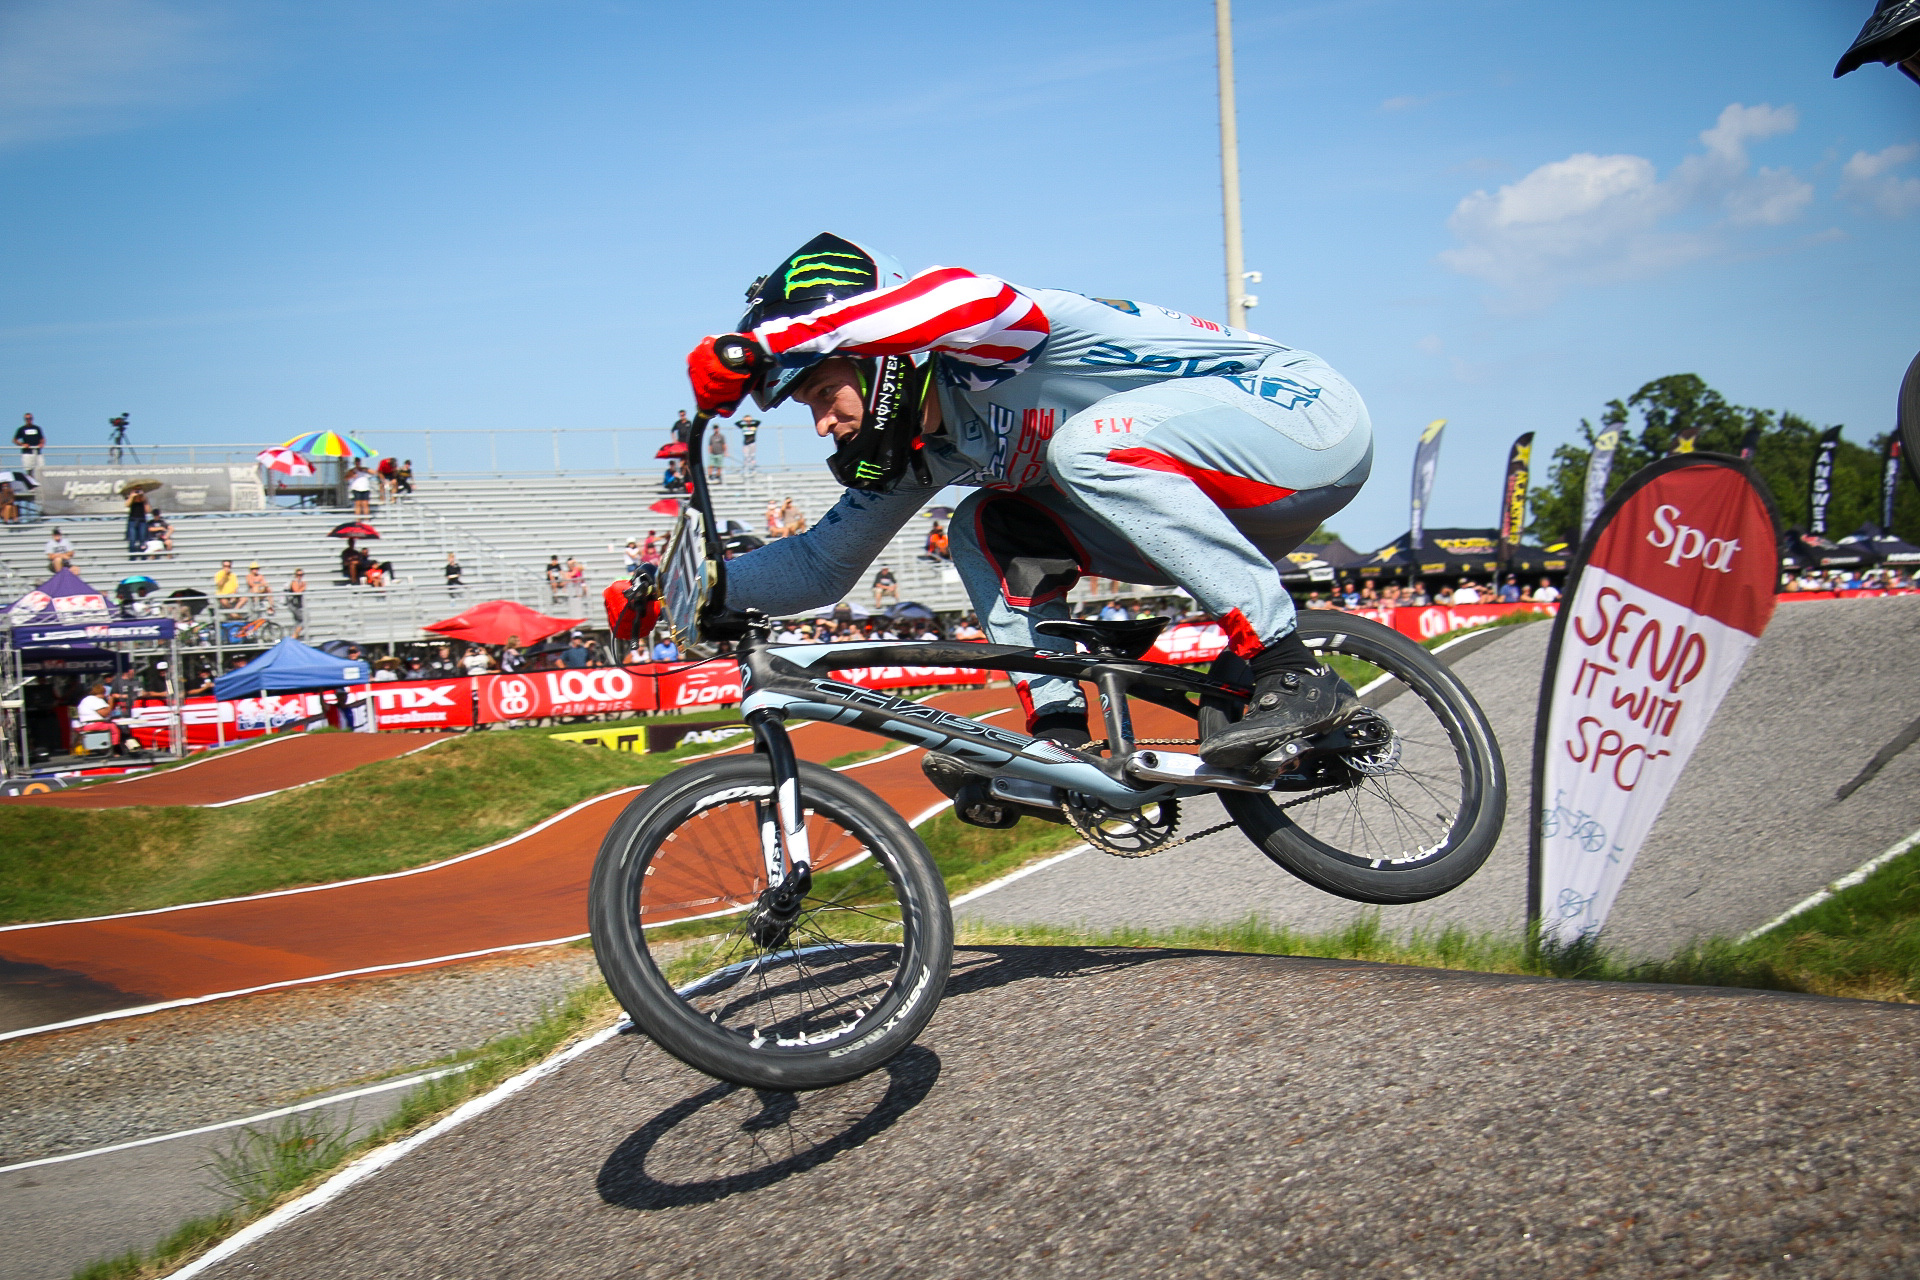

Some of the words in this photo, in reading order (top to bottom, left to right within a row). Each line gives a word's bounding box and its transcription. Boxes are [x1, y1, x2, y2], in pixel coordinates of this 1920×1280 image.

[1093, 418, 1134, 434] FLY
[62, 480, 114, 499] Honda
[1808, 451, 1832, 533] ANSWER
[1646, 504, 1742, 574] Spot
[1574, 586, 1707, 693] SEND
[547, 668, 633, 704] LOCO
[1572, 658, 1616, 698] IT
[1566, 716, 1672, 792] SPOT
